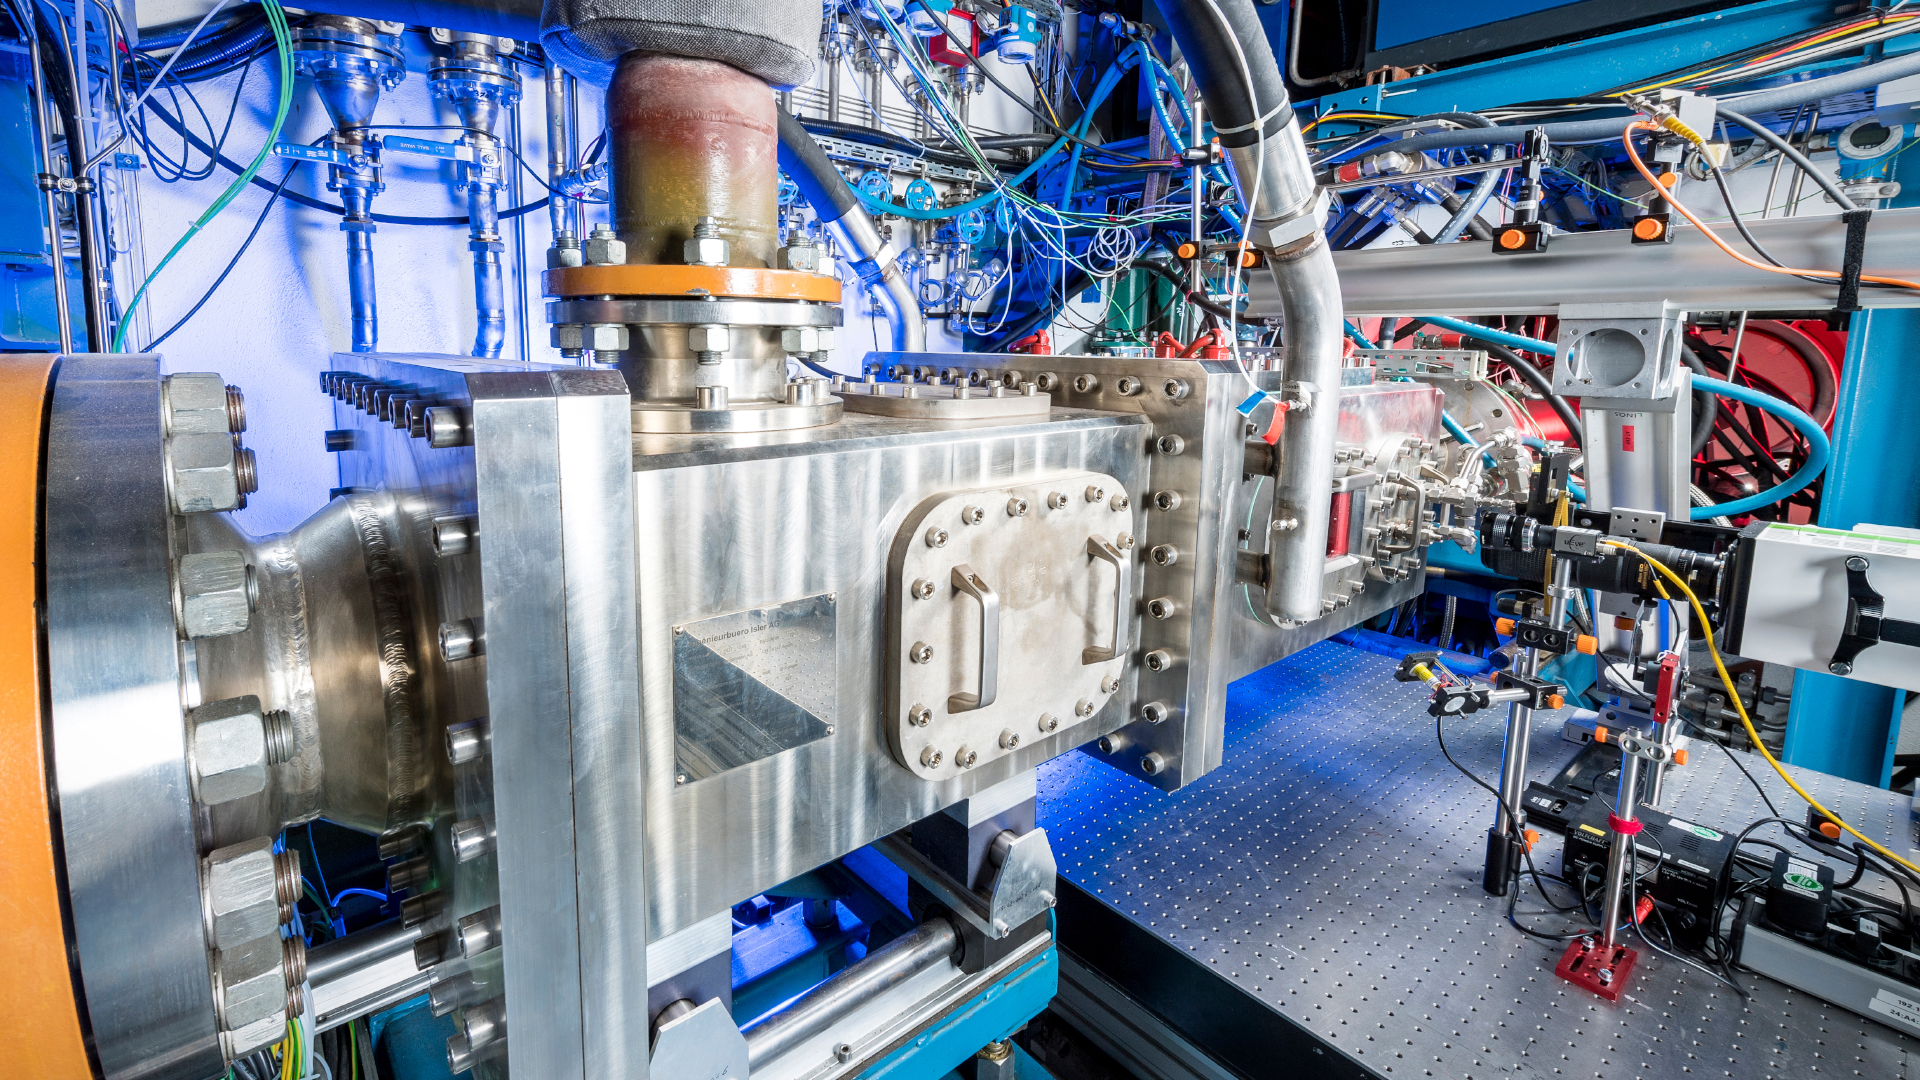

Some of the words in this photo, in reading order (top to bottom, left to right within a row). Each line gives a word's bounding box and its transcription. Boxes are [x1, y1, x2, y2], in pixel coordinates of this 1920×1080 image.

[689, 629, 749, 647] Ingenieurbuero
[750, 624, 767, 634] Isler
[768, 620, 780, 629] AG
[1573, 829, 1606, 844] VOLTCRAFT
